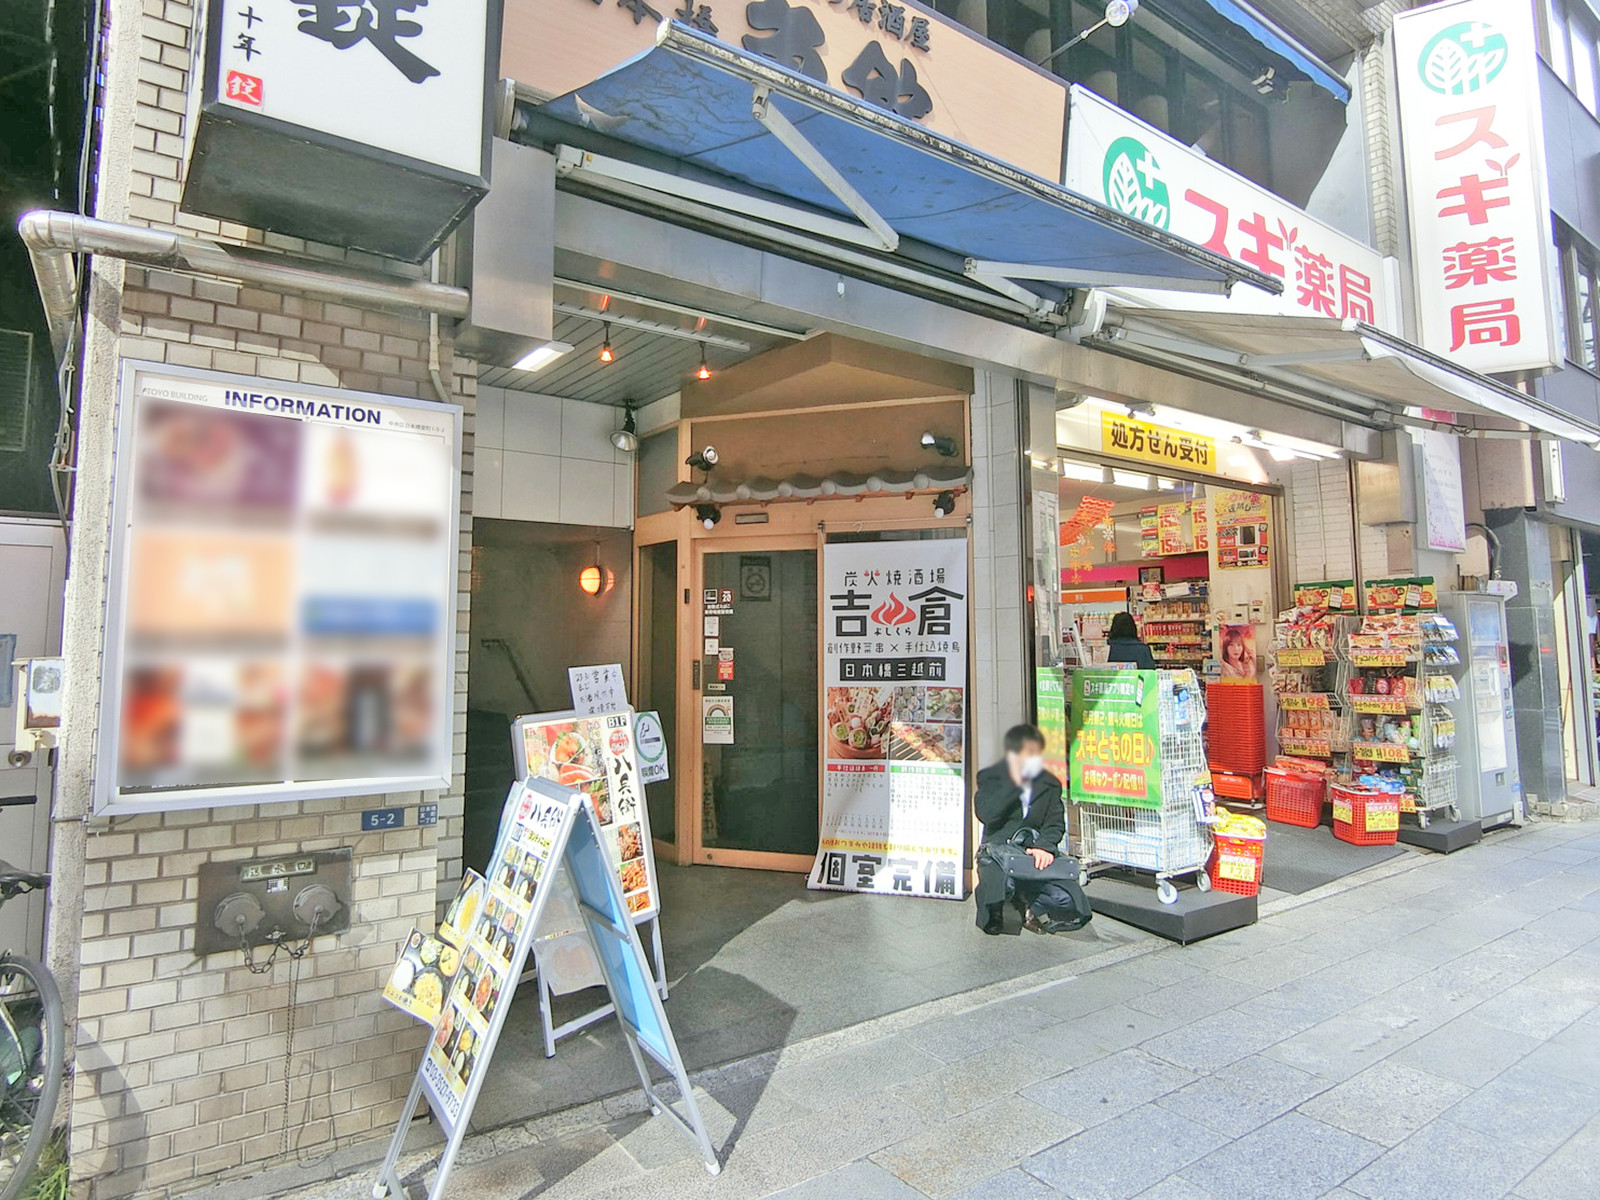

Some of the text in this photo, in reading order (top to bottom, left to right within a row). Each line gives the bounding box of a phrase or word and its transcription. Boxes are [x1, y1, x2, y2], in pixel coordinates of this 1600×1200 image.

[1434, 105, 1521, 353] スギ薬局
[1184, 187, 1375, 327] スギ薬局
[170, 390, 208, 403] BUILDING
[224, 390, 381, 425] INFORMATION
[1111, 421, 1208, 466] 処方せん受付
[844, 567, 946, 587] 炭火焼酒場
[829, 586, 965, 637] 吉倉
[873, 627, 912, 636] よしくら
[845, 661, 942, 678] 日本橋三越前
[371, 813, 395, 826] 5-2
[817, 852, 957, 895] 個室完備
